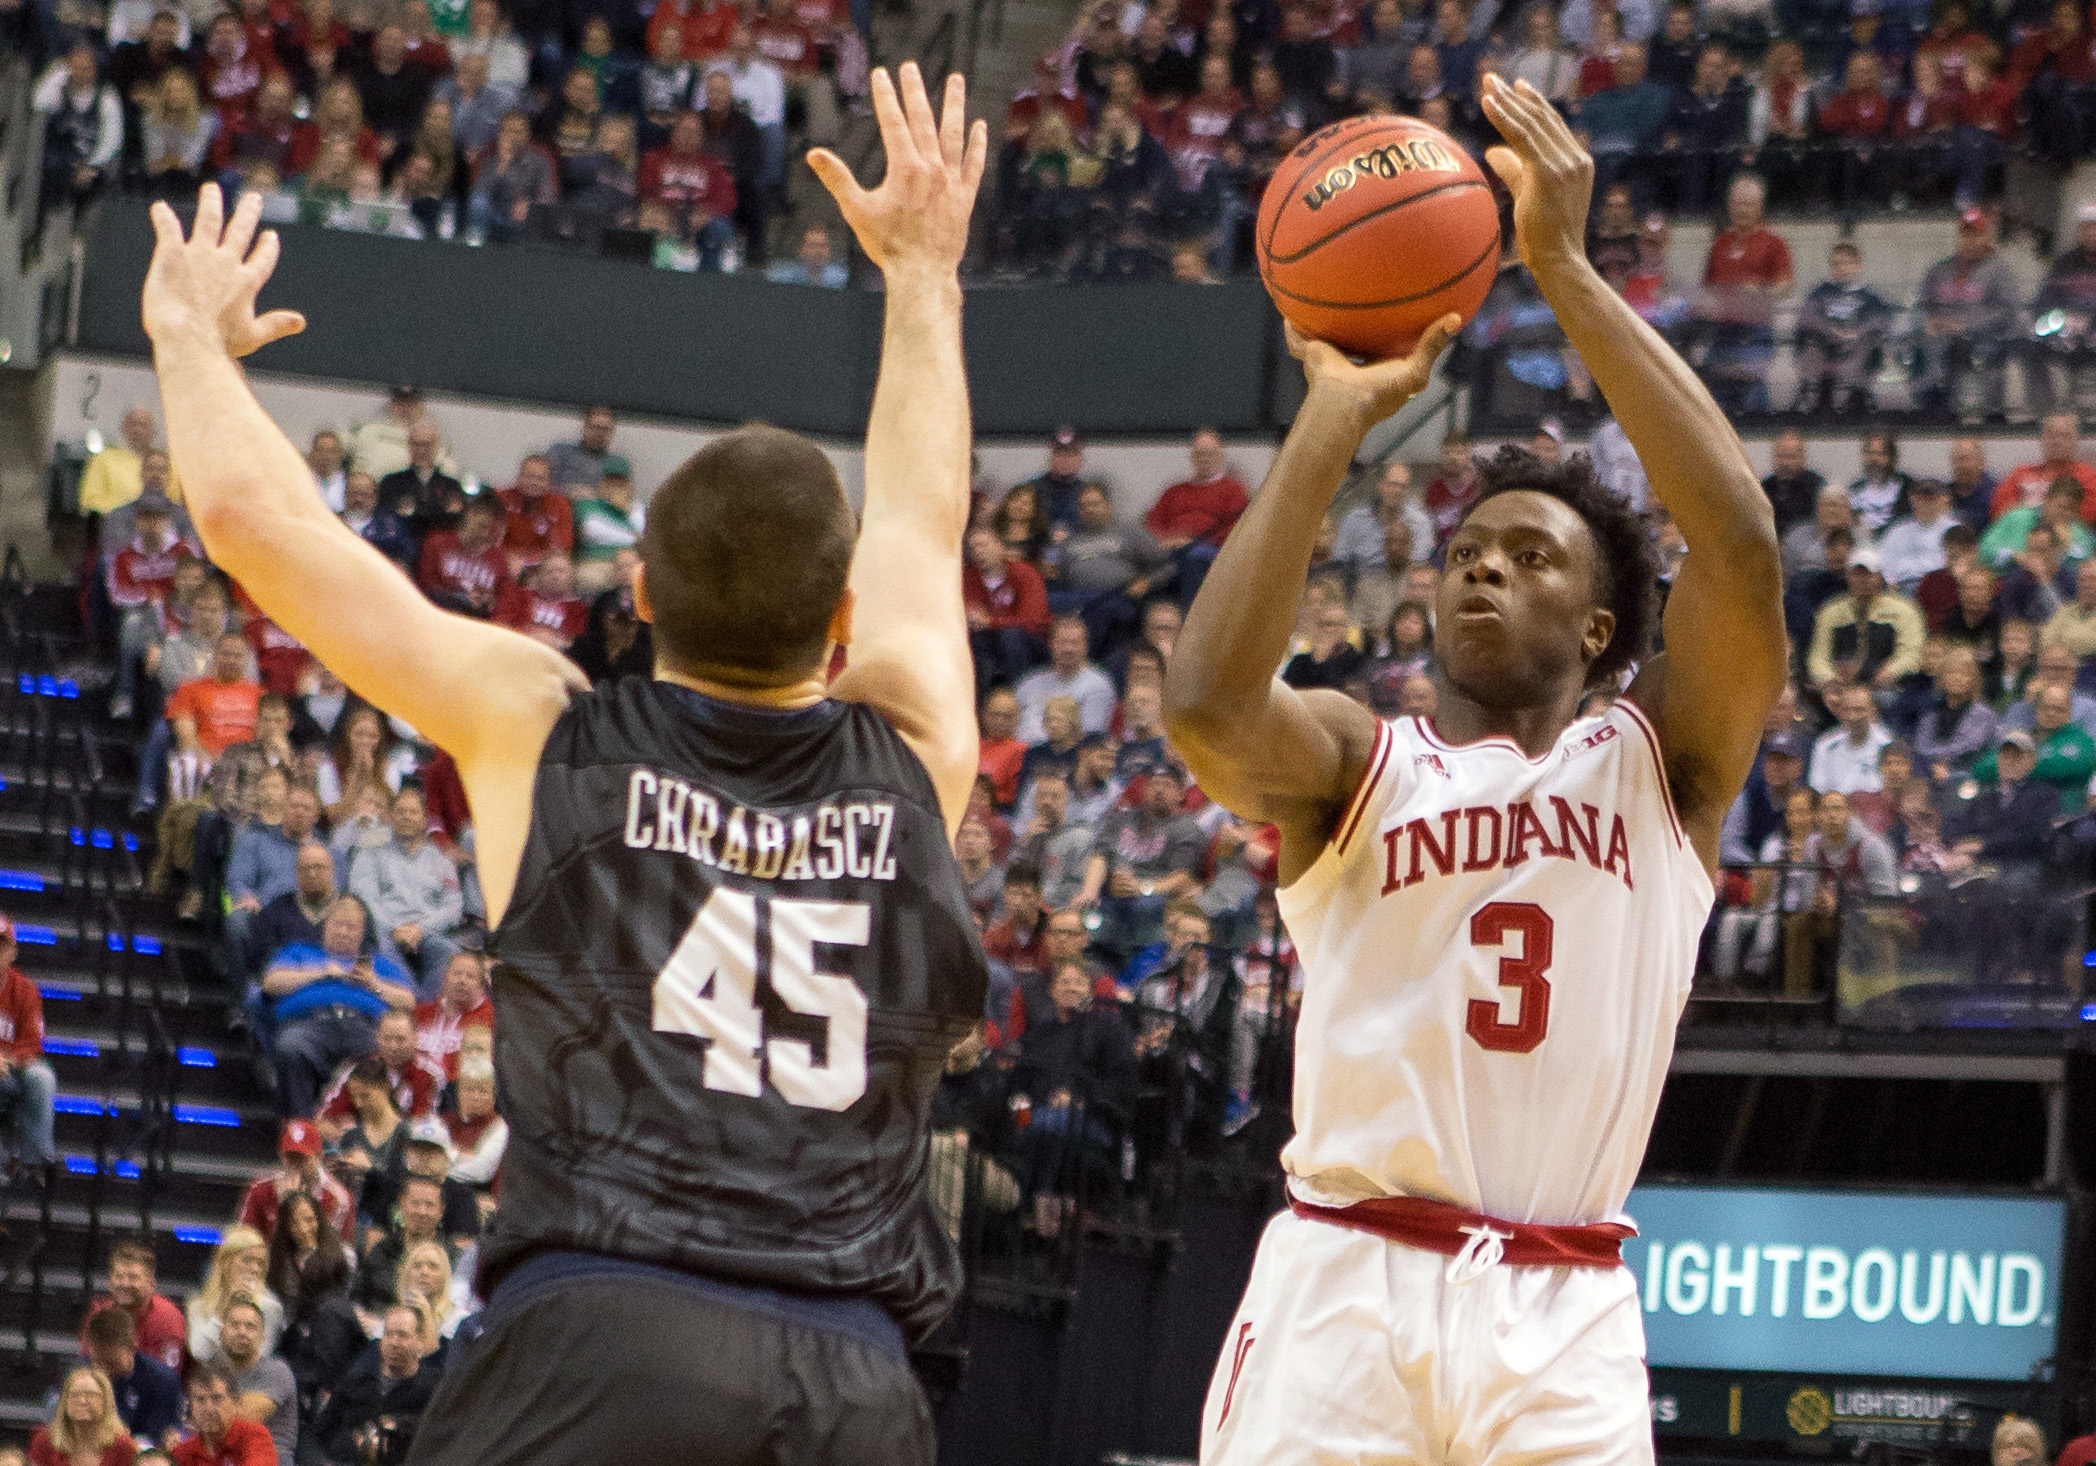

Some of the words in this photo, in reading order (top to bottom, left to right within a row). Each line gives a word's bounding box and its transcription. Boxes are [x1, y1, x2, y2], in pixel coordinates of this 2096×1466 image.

[1303, 139, 1462, 212] Wilson
[624, 767, 898, 881] CHRABASCZ
[1381, 794, 1634, 898] INDIANA
[651, 884, 871, 1112] 45
[1465, 901, 1554, 1054] 3
[1644, 1240, 2056, 1327] IGHTBOUND.
